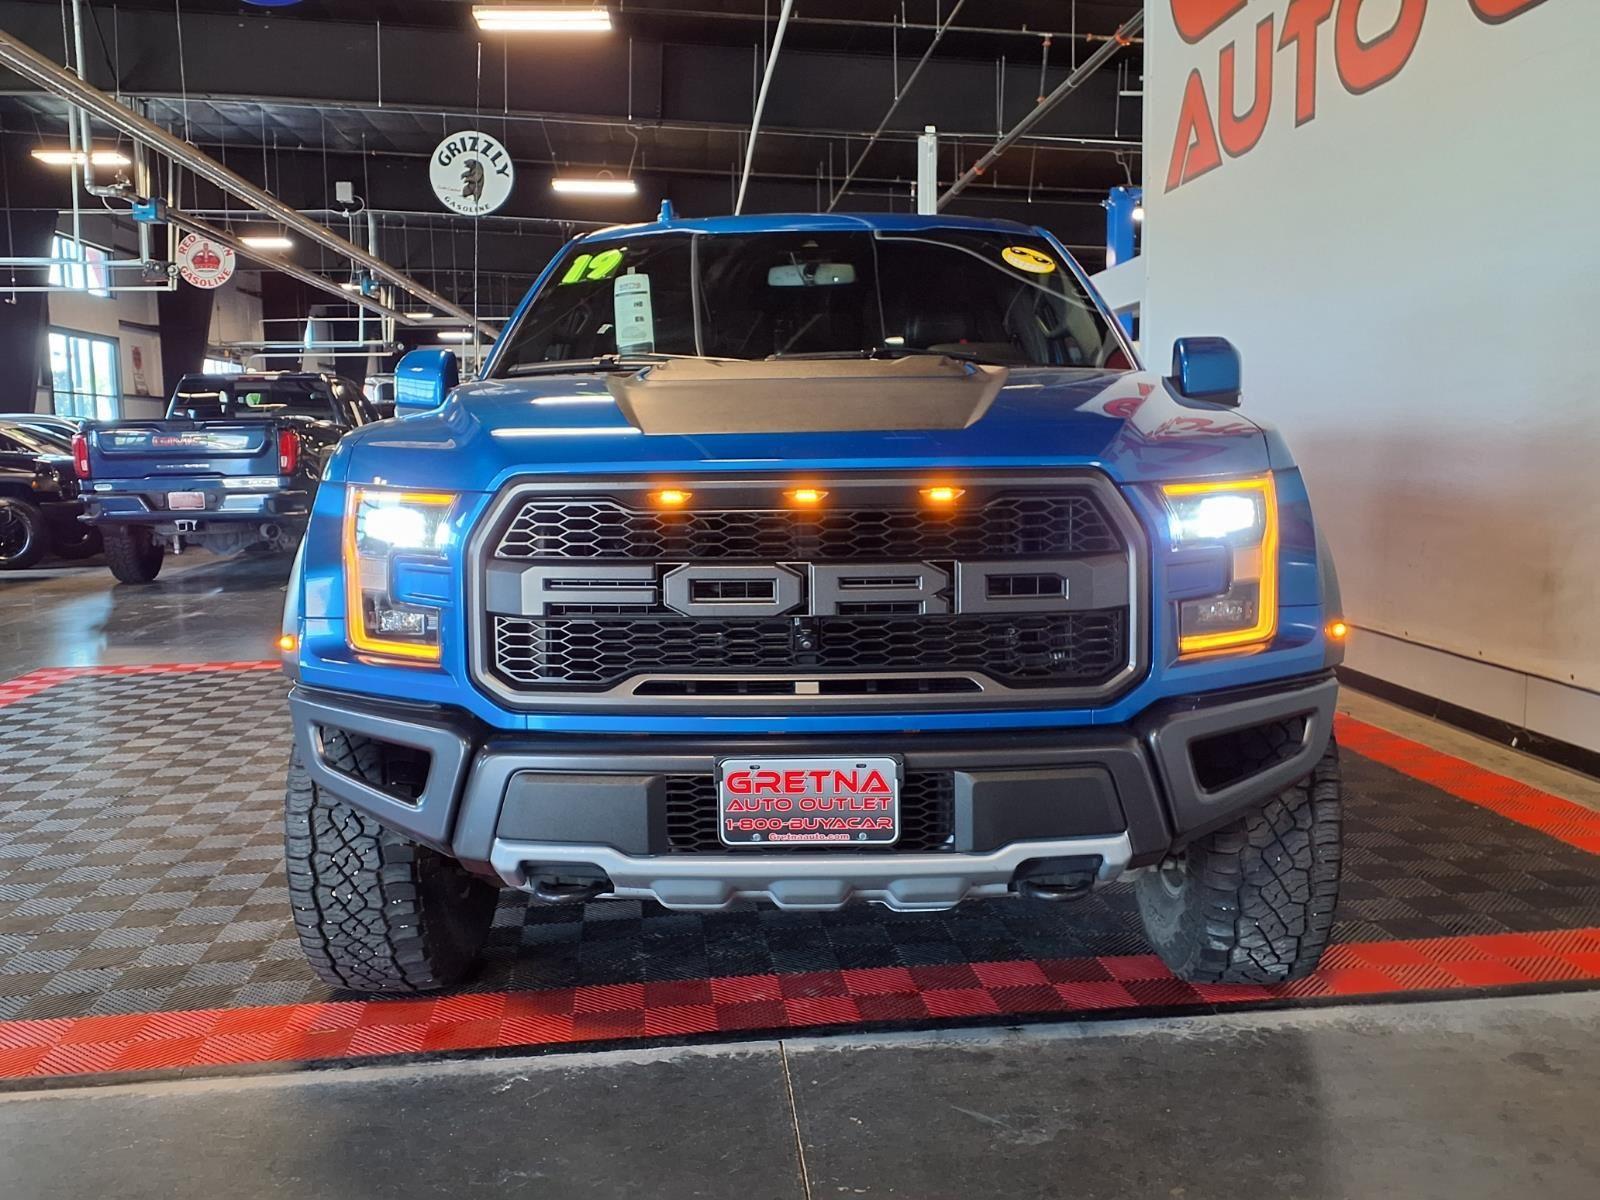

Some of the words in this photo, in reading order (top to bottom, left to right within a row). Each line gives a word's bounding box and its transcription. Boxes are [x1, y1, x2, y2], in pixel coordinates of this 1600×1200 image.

[1164, 0, 1428, 194] AUTO
[438, 136, 509, 178] GRIZZLY
[444, 196, 490, 212] GASOLINE
[179, 235, 197, 255] RED
[180, 265, 231, 287] GASOLINE
[560, 249, 623, 284] 19
[520, 558, 1095, 617] FORD
[726, 769, 892, 795] GRETNA
[726, 798, 793, 812] AUTO
[798, 797, 893, 811] OUTLET
[725, 817, 893, 830] 1-800-BUYACAR
